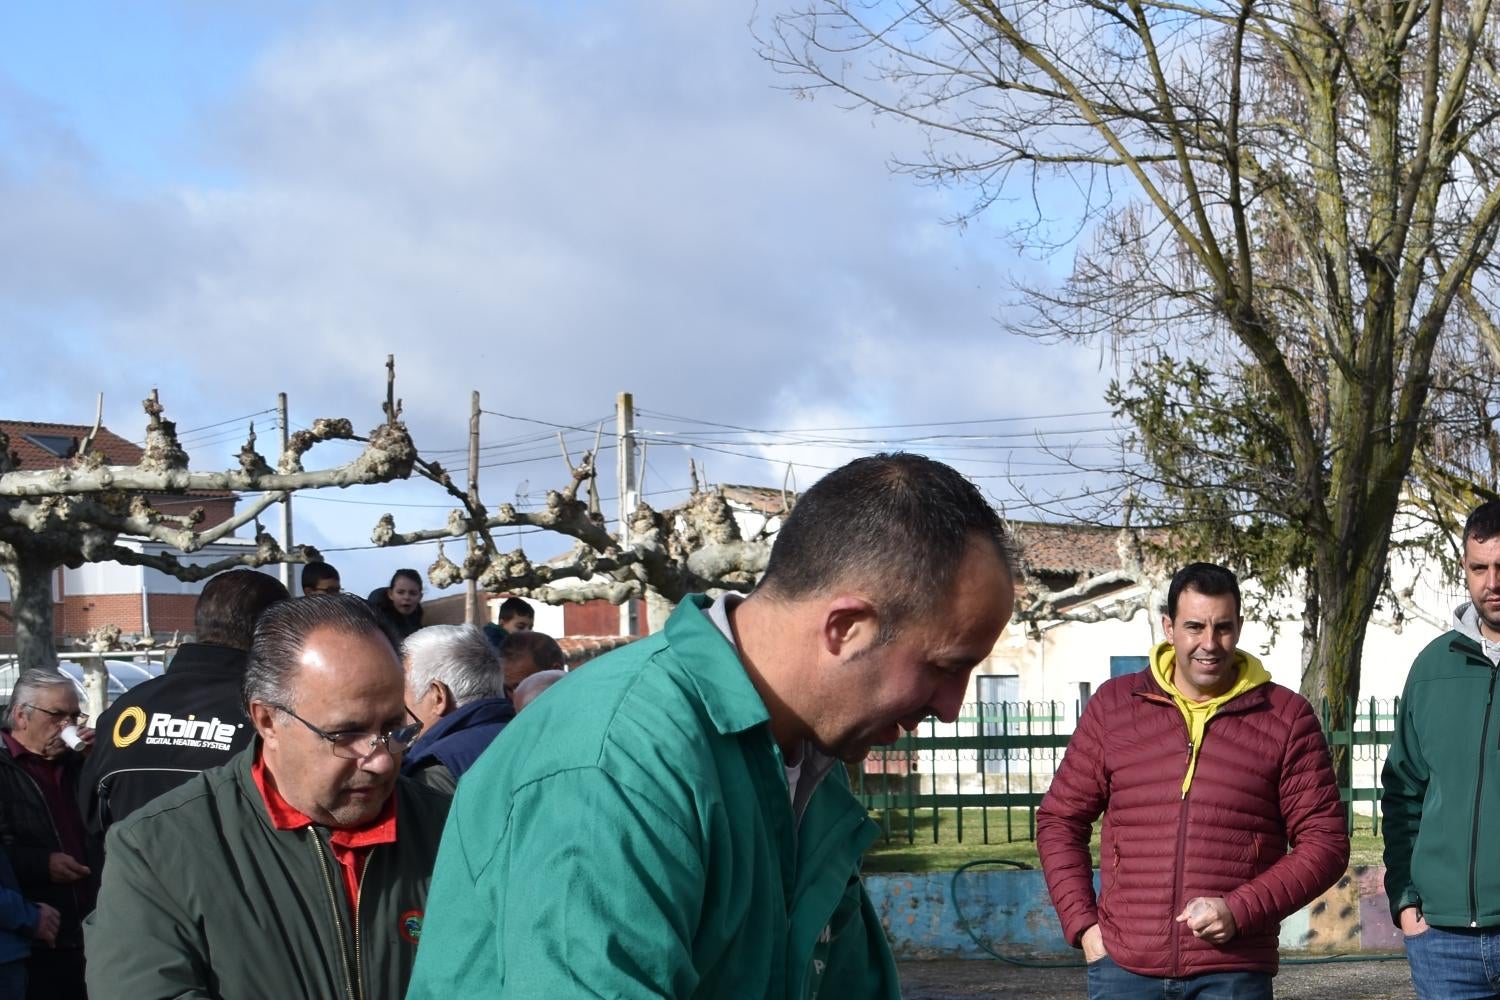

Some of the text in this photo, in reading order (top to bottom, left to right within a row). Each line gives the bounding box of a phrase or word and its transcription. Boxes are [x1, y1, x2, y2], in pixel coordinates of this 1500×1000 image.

[147, 713, 236, 743] Rointe
[146, 737, 231, 751] DIGITAL HEATING SYSTEM
